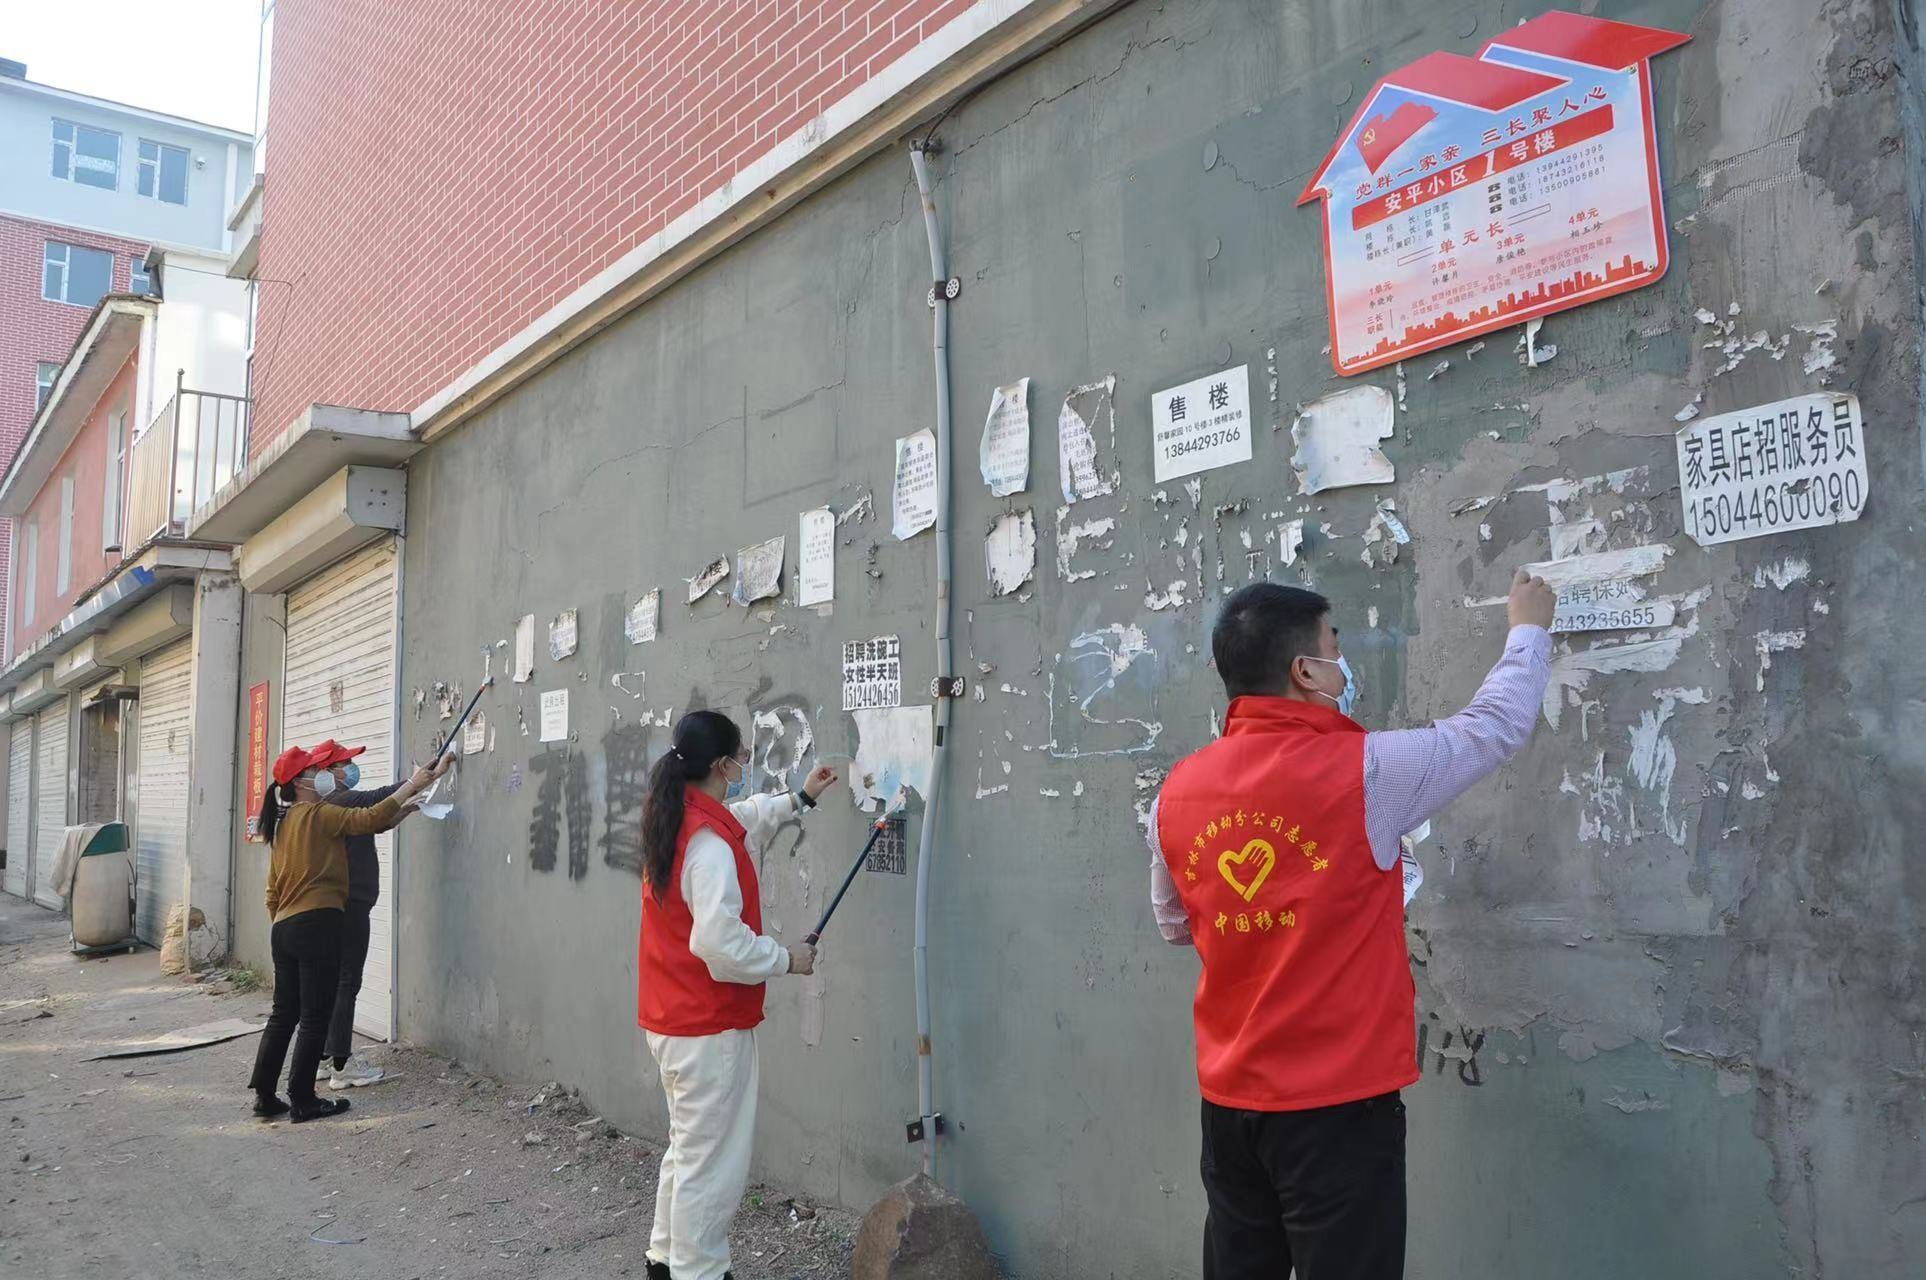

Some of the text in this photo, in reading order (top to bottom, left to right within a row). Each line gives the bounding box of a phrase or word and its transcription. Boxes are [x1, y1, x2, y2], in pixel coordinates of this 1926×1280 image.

[1356, 87, 1607, 199] 党群一家亲 三长聚人心
[1384, 130, 1557, 214] 安平小区1号楼
[1438, 221, 1504, 254] 单元长
[1496, 232, 1525, 250] 3单元
[1568, 207, 1599, 225] 4单元
[1169, 382, 1229, 422] 售楼
[1165, 427, 1240, 459] 13844293766
[1684, 399, 1857, 490] 家具店招服务员
[845, 662, 898, 683] 女性半天班
[845, 683, 898, 708] 15124426456
[1214, 910, 1296, 936] 中国移动
